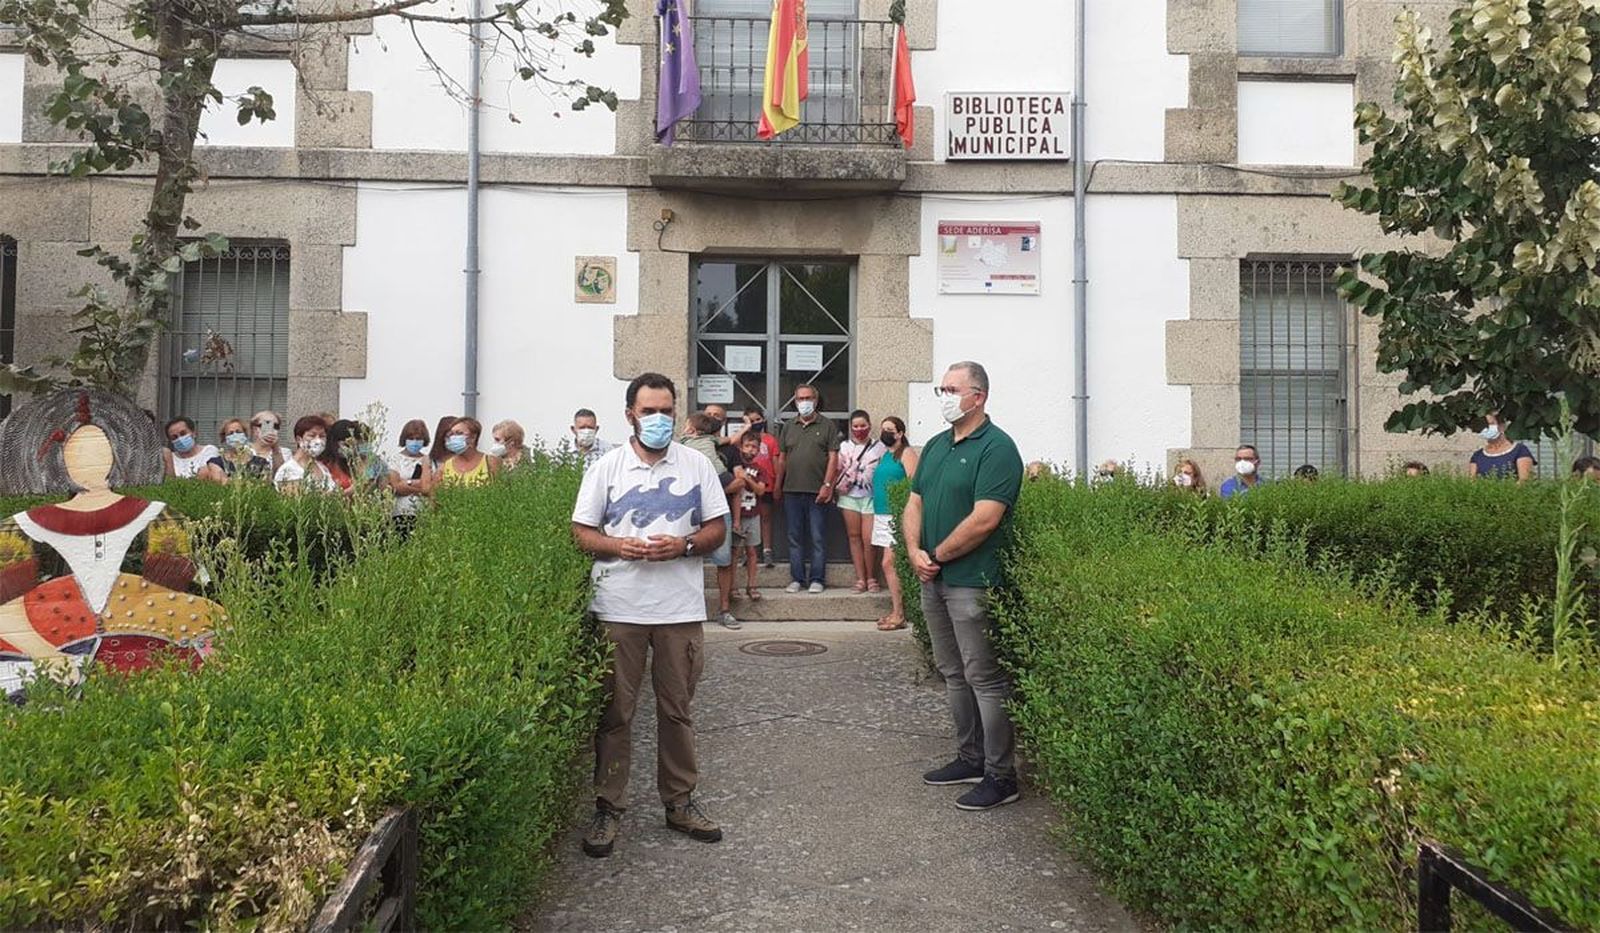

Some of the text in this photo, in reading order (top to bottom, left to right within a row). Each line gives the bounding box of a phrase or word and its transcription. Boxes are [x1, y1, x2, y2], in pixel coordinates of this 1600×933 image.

[953, 97, 1064, 114] BIBLIOTECA
[966, 117, 1052, 134] PUBLICA
[954, 136, 1064, 154] MUNICIPAL
[944, 226, 1002, 235] SEDE ADERISA
